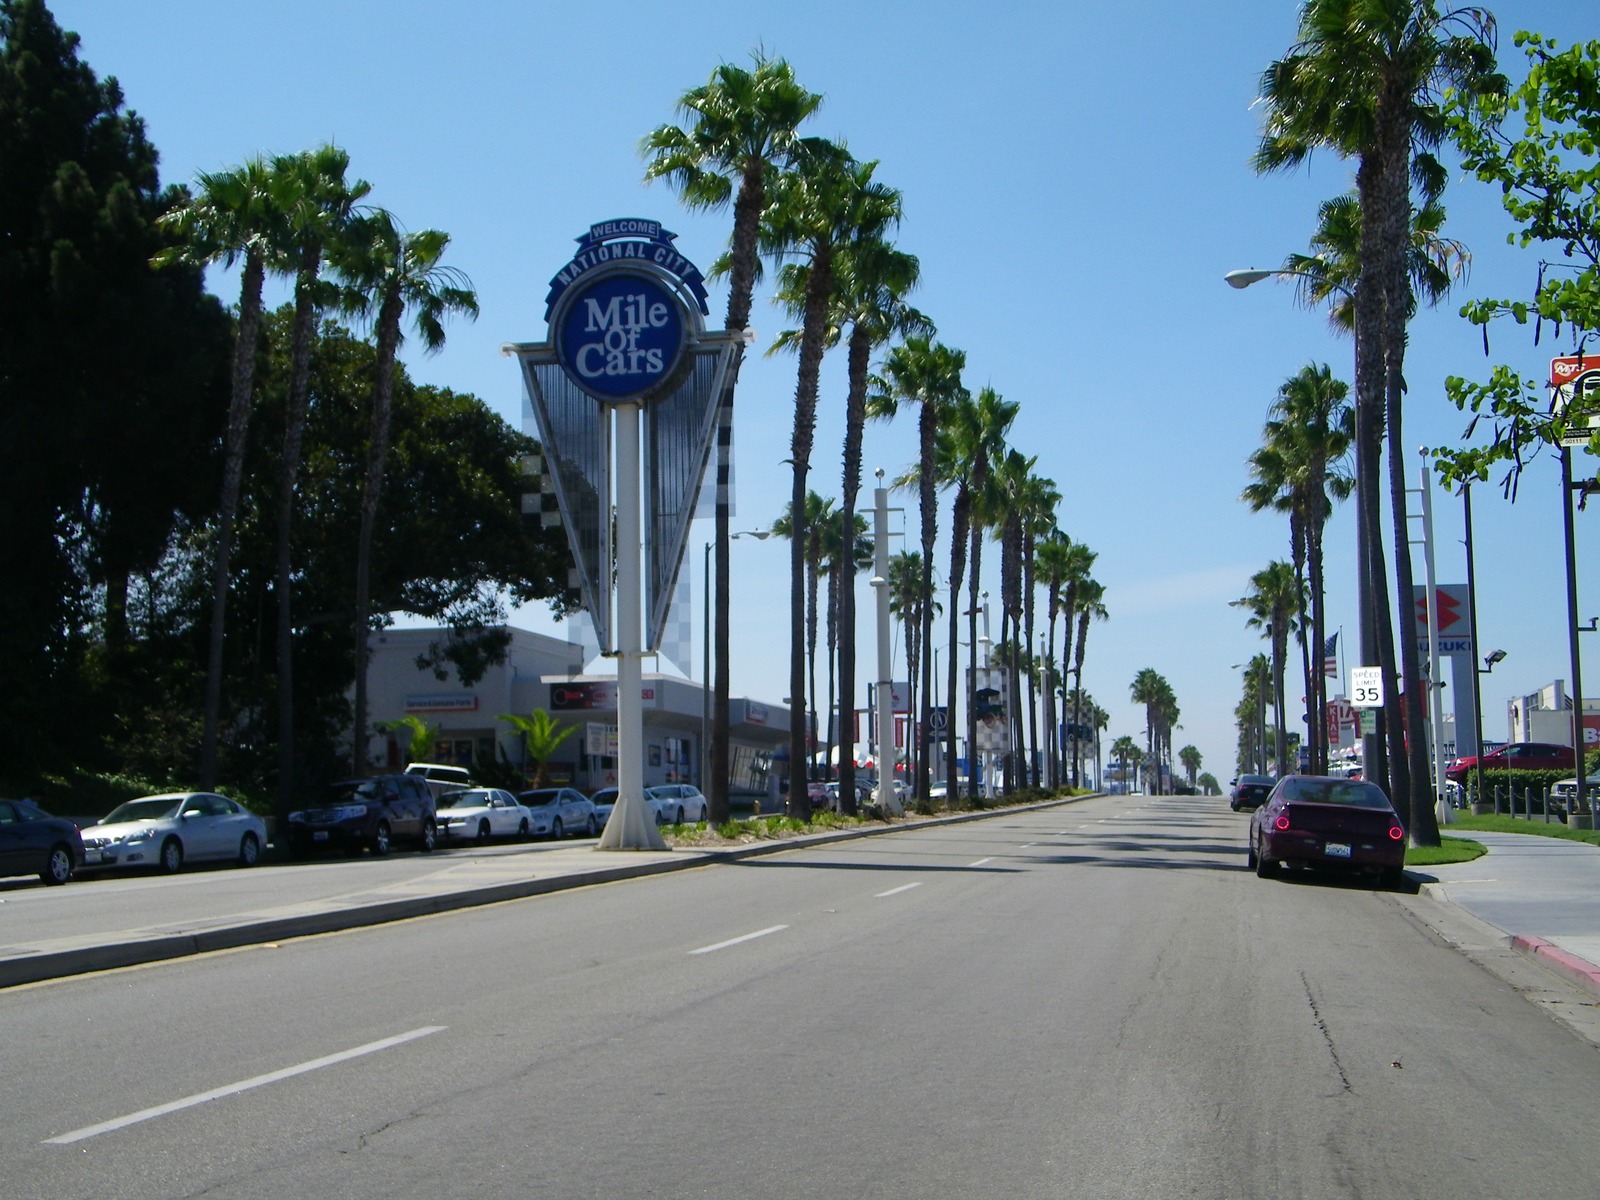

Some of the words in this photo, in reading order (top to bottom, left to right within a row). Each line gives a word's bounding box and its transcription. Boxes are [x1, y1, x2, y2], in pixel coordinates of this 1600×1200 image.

[592, 221, 657, 238] WELCOME
[557, 243, 646, 286] NATIONAL
[653, 248, 695, 279] CITY
[583, 293, 669, 332] Mile
[575, 342, 664, 378] Cars
[1353, 671, 1380, 679] SPEED
[1355, 687, 1380, 702] 35
